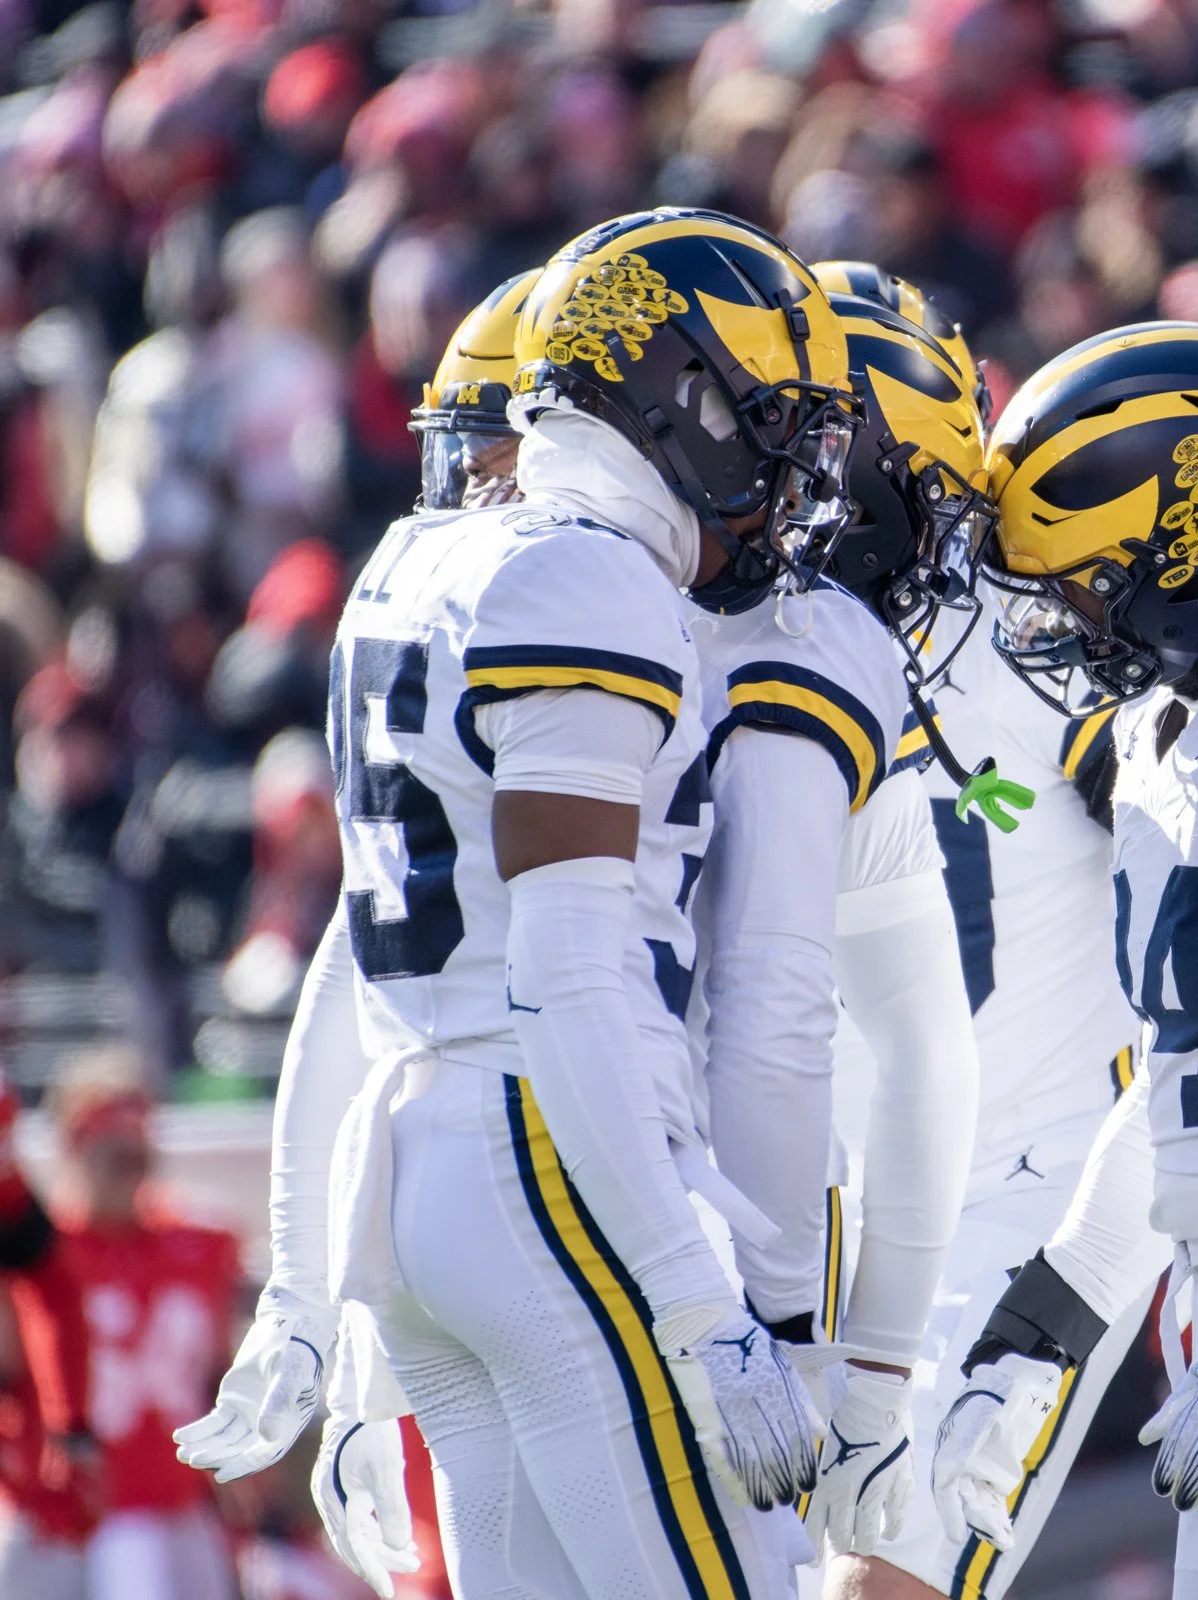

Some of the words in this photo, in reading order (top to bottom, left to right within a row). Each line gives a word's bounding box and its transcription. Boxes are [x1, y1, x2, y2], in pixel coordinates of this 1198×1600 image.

[457, 383, 481, 405] M
[1163, 568, 1188, 585] TED
[328, 636, 464, 980] 5
